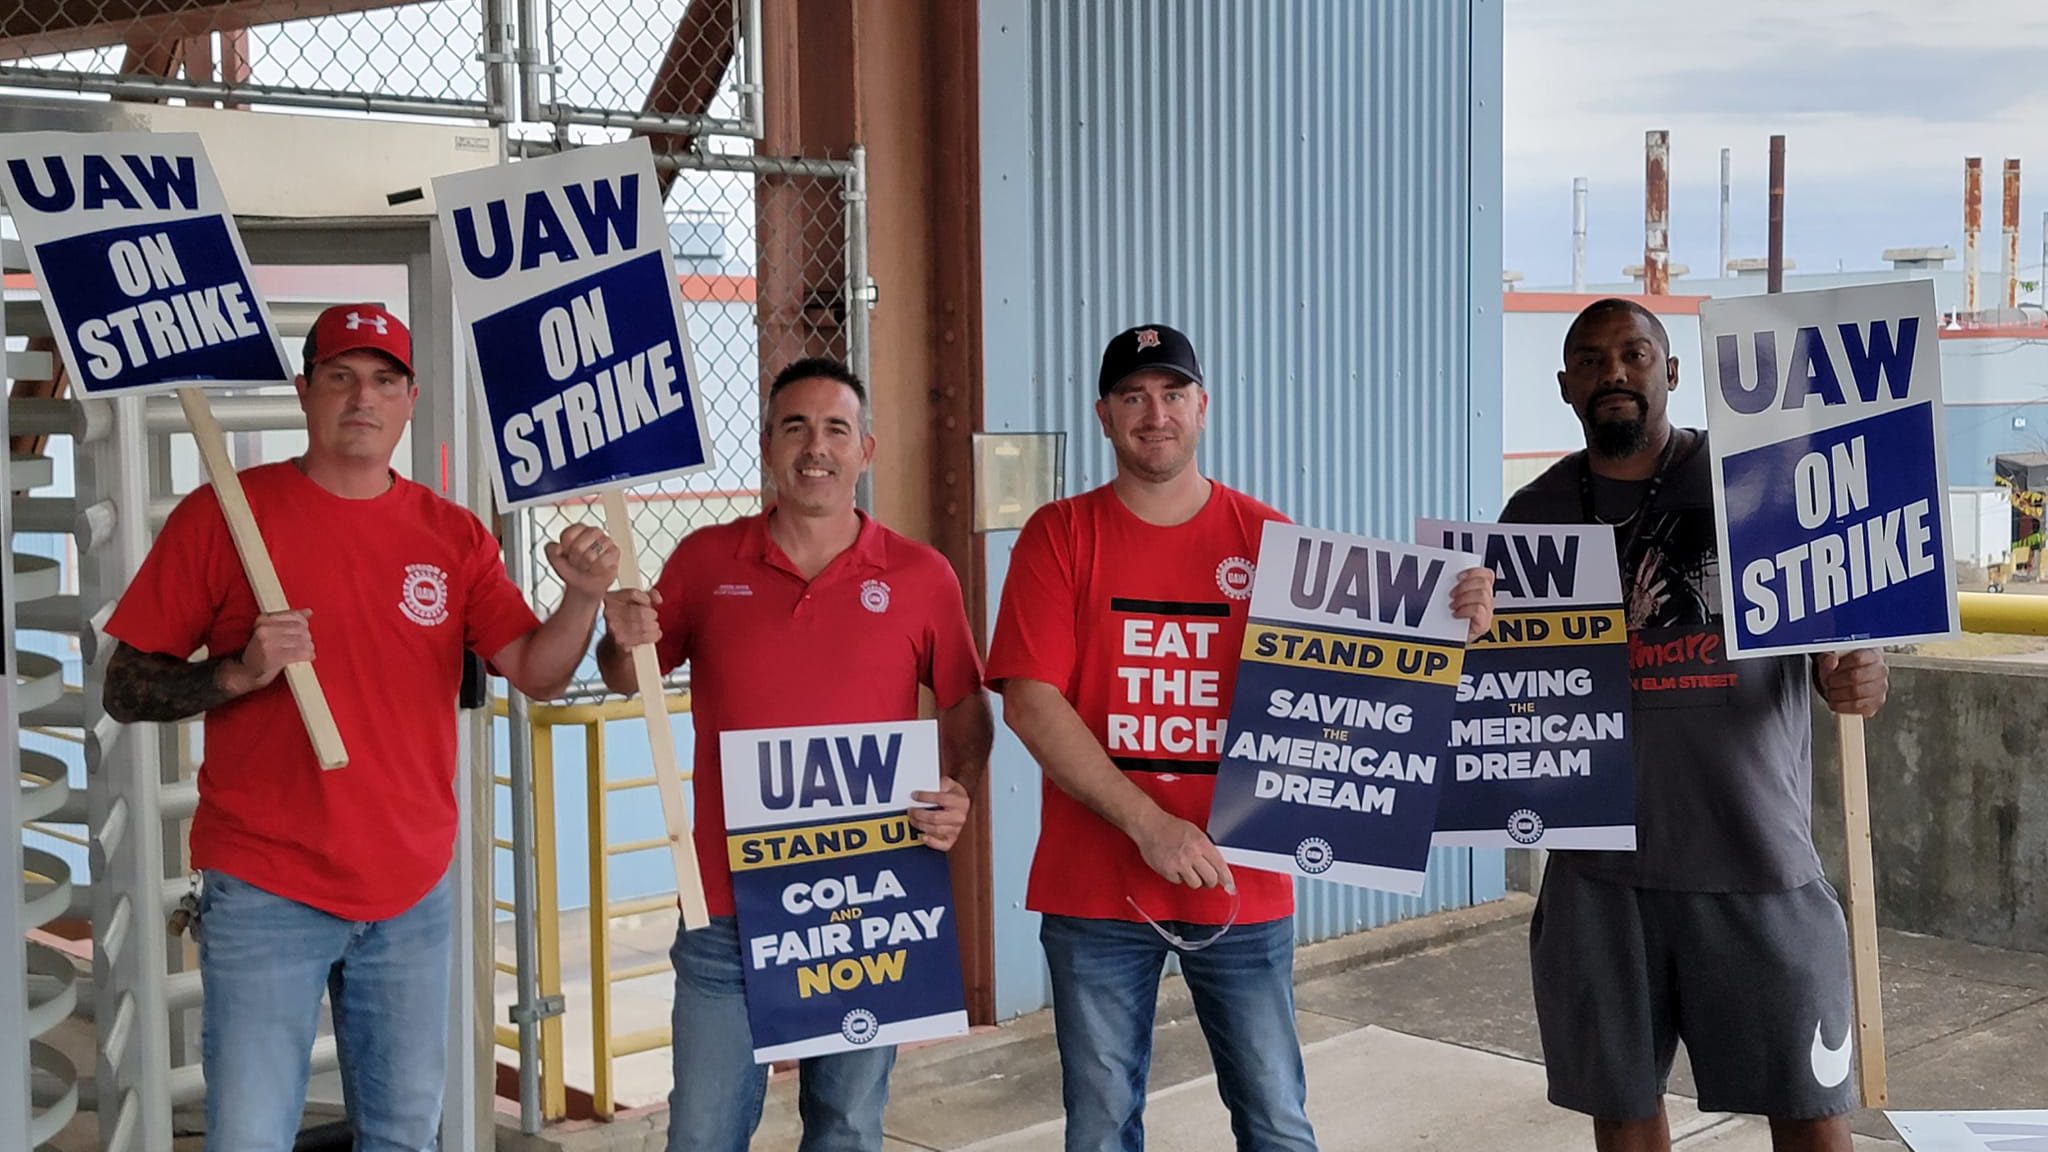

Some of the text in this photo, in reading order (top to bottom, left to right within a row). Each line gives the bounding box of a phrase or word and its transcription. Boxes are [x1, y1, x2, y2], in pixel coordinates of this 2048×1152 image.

[7, 155, 199, 213] UAW
[453, 173, 639, 280] UAW
[108, 232, 186, 297] ON
[77, 282, 260, 380] STRIKE
[539, 286, 615, 382] ON
[1716, 317, 1919, 414] UAW
[503, 340, 684, 487] STRIKE
[1794, 435, 1869, 529] ON
[1227, 572, 1247, 585] UAW
[1290, 537, 1446, 628] UAW
[1742, 498, 1934, 635] STRIKE
[1123, 619, 1219, 659] EAT
[1562, 616, 1612, 639] UP
[1255, 632, 1449, 676] STAND UP
[1117, 666, 1220, 707] THE
[1455, 668, 1593, 702] SAVING
[1679, 673, 1738, 689] STREET
[1266, 689, 1413, 734] SAVING
[1447, 712, 1624, 747] MERICAN
[1509, 702, 1535, 713] THE
[1107, 713, 1228, 754] RICH
[1322, 727, 1348, 741] THE
[757, 733, 903, 810] UAW
[1228, 731, 1437, 784] AMERICAN
[1456, 748, 1591, 781] DREAM
[1254, 771, 1396, 815] DREAM
[742, 828, 868, 864] STAND
[782, 870, 907, 915] COLA
[830, 907, 863, 923] AND
[750, 906, 946, 971] FAIR PAY
[797, 950, 907, 998] NOW
